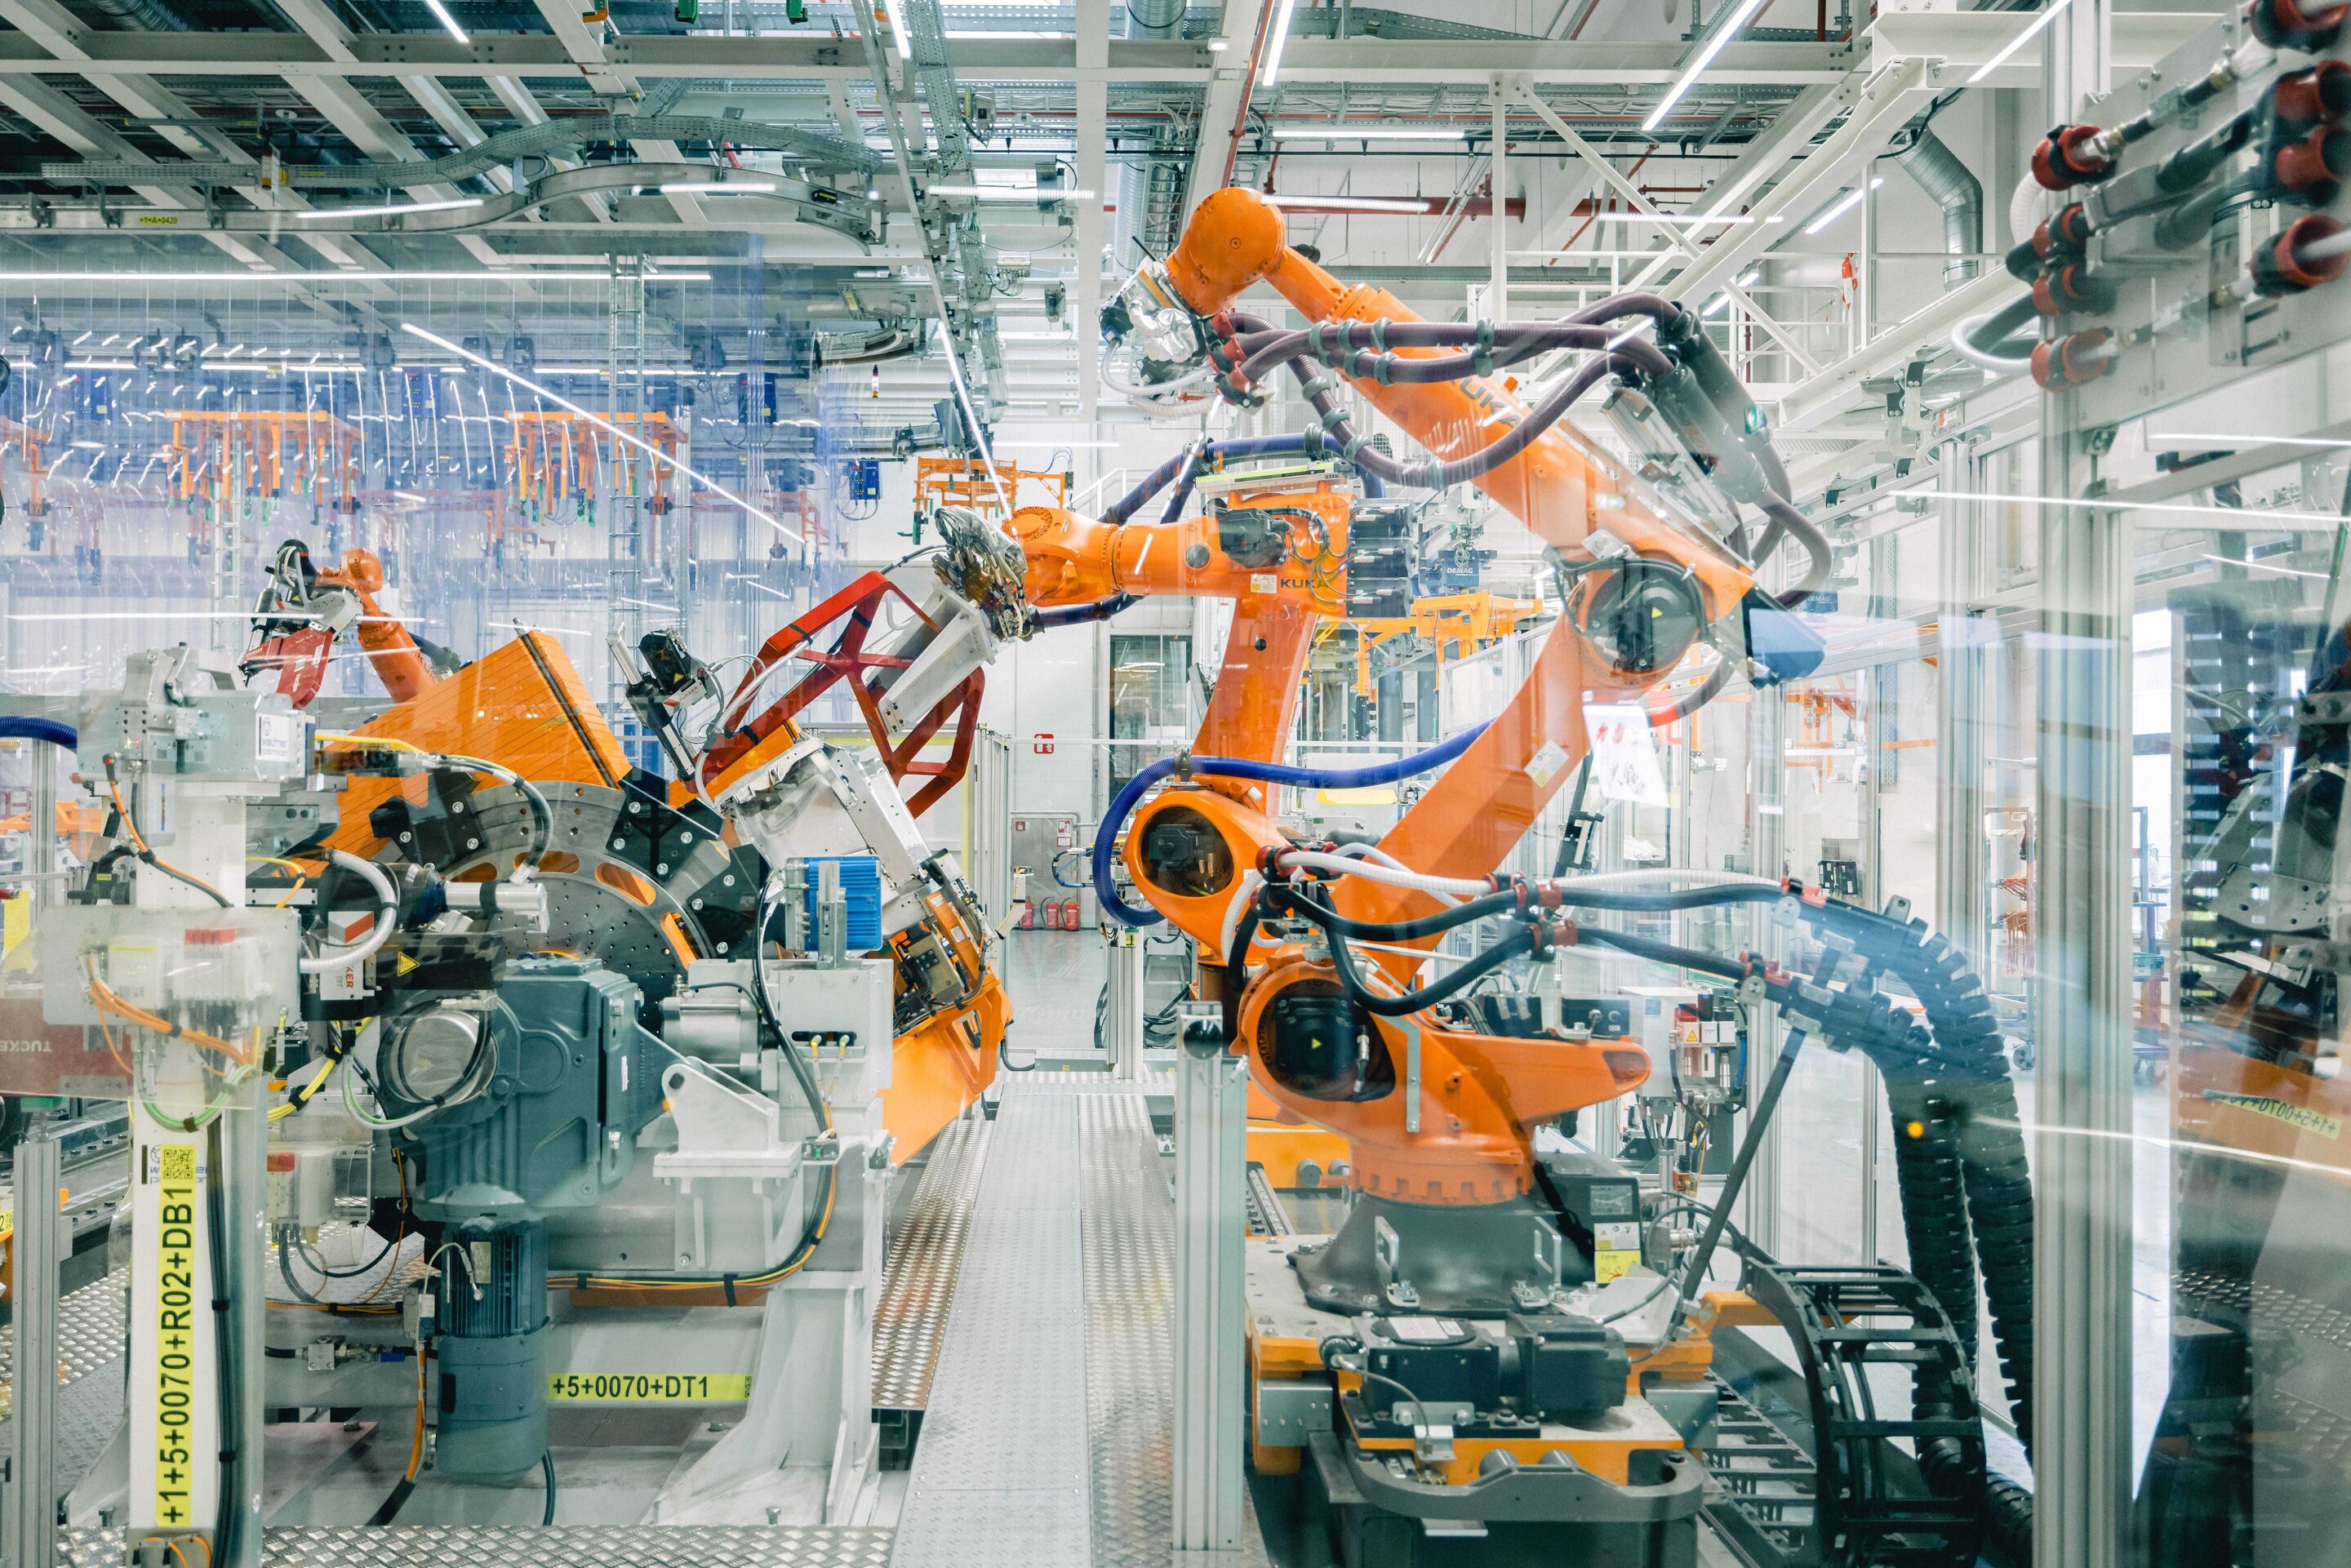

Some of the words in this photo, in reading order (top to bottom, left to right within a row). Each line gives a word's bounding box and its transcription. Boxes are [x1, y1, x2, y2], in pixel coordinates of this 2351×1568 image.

[1450, 375, 1522, 428] UKA
[1280, 578, 1328, 589] KUKA
[679, 686, 698, 701] TUCKER
[159, 1188, 193, 1523] +1+5+0070+R02+DB1
[553, 1375, 708, 1398] +5+0070+DT1
